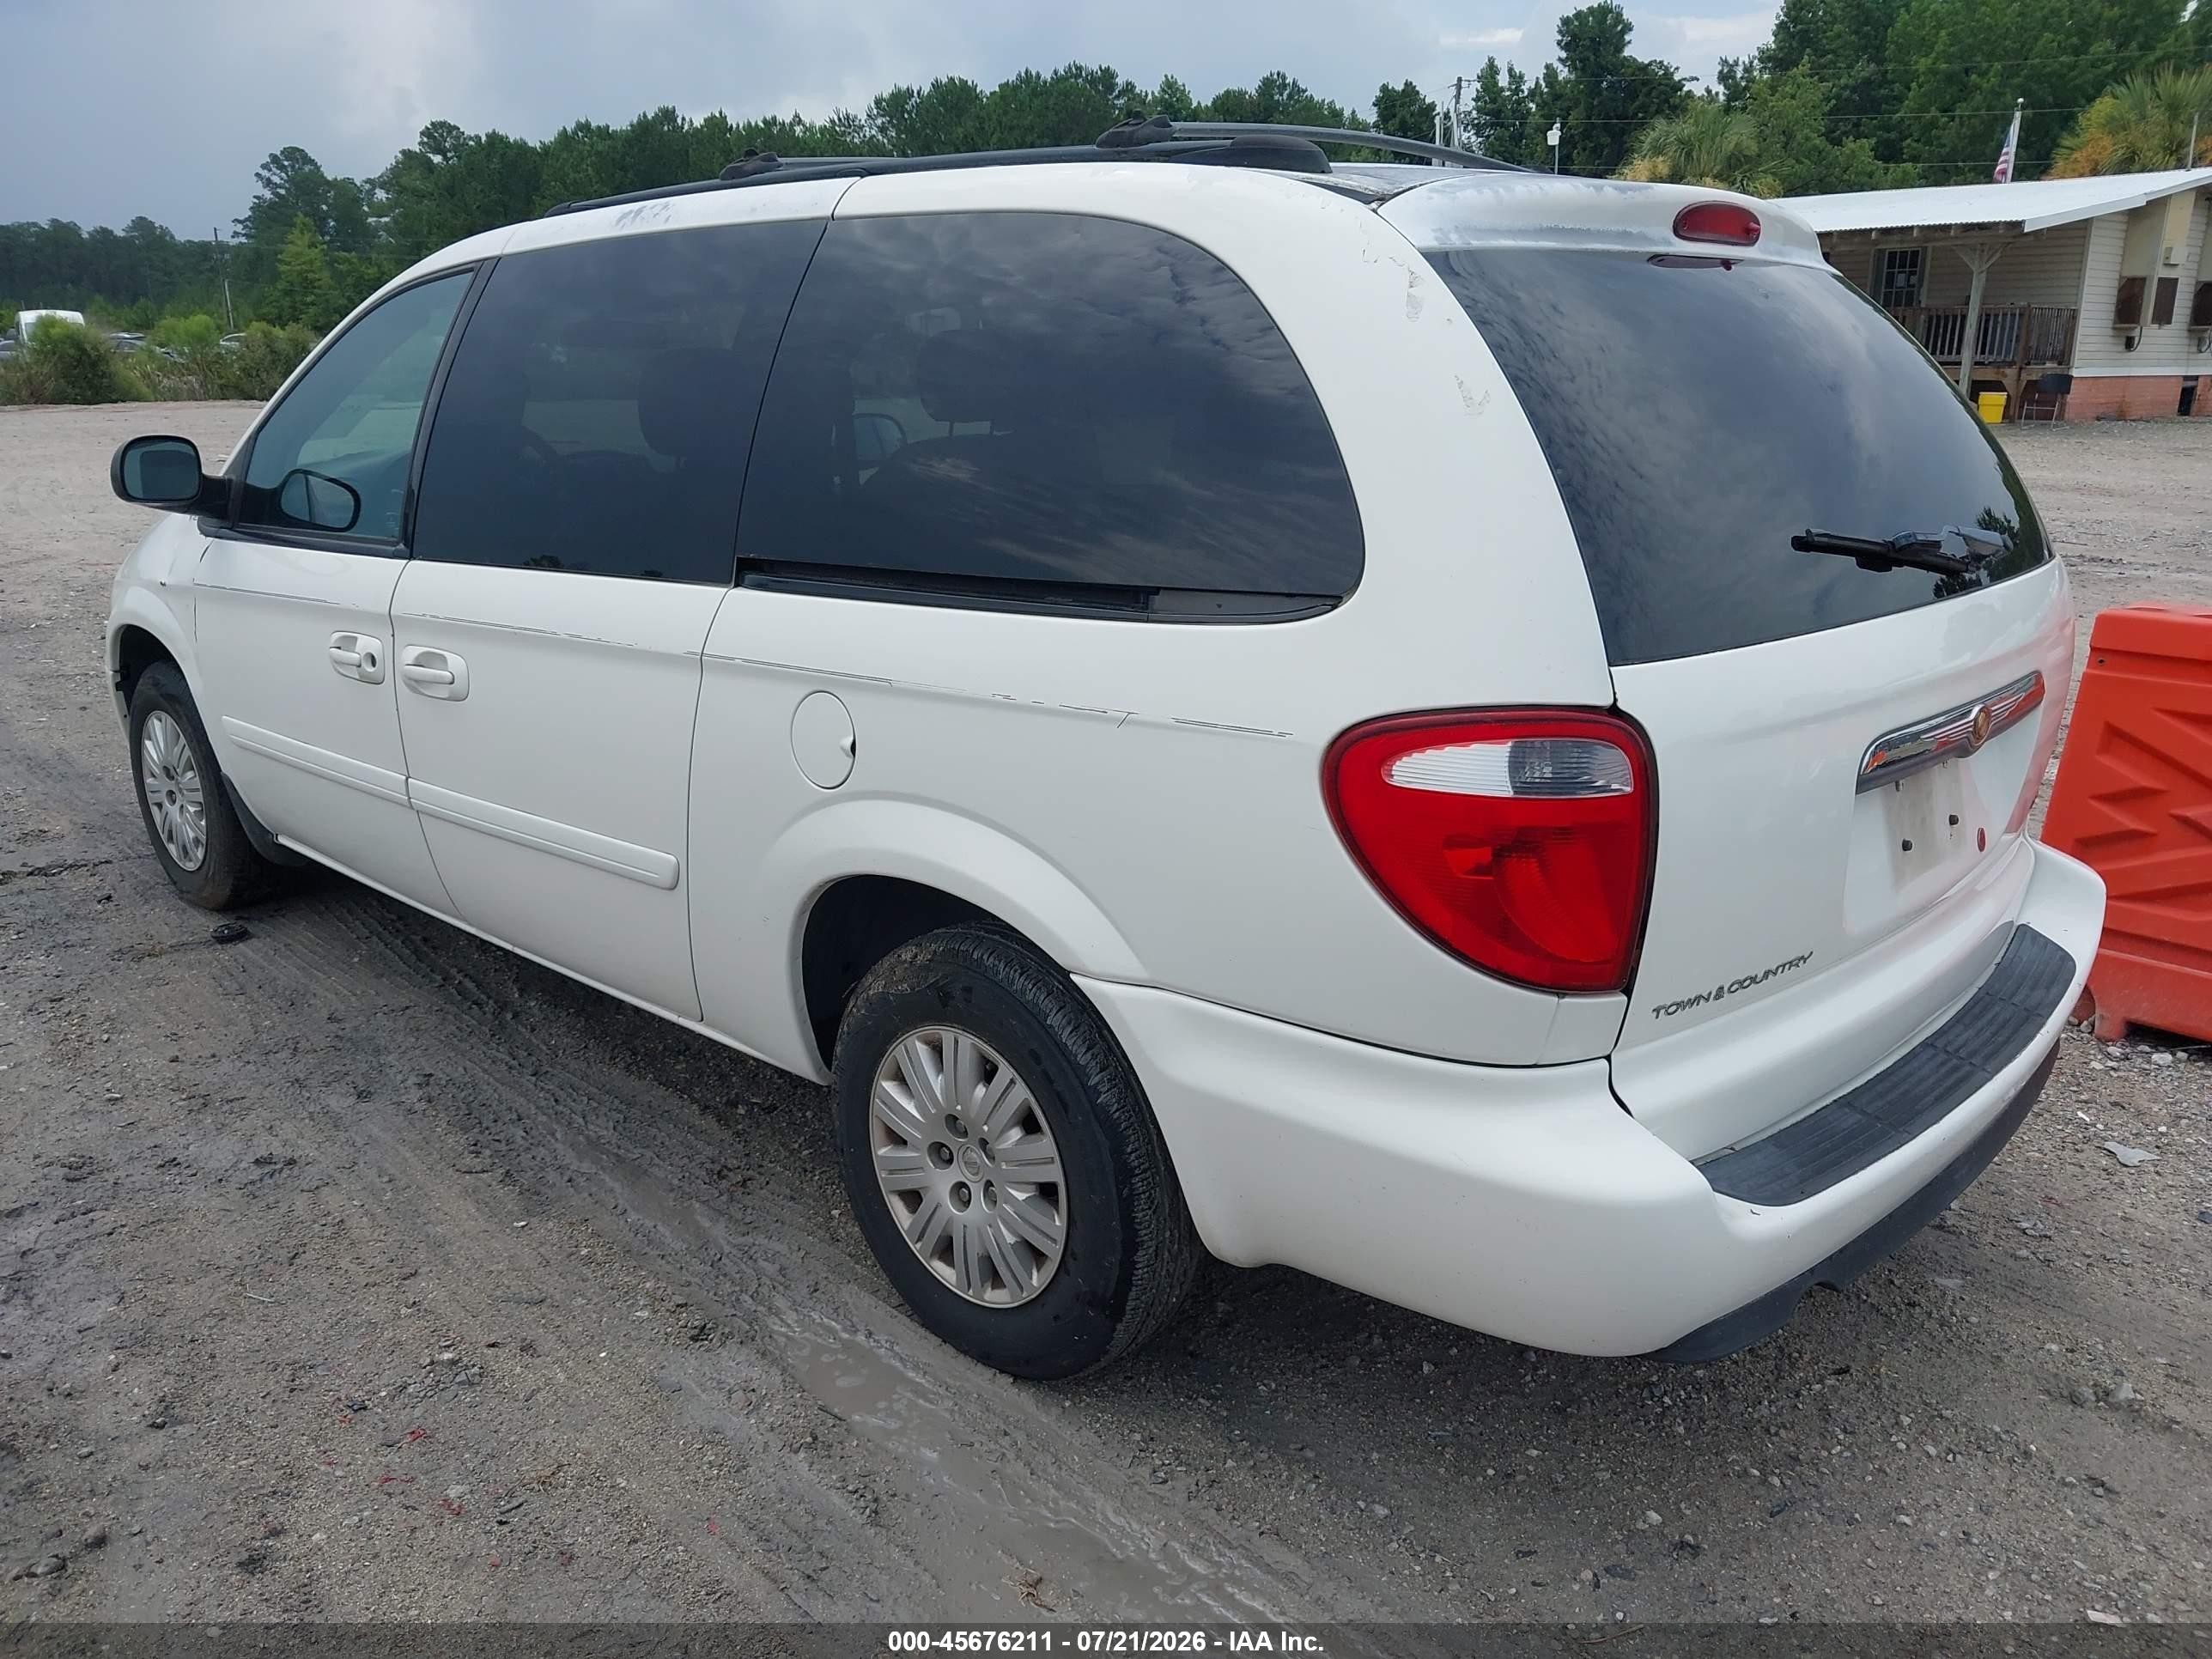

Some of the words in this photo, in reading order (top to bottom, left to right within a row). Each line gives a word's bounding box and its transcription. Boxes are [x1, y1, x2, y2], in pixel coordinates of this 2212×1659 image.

[1652, 991, 1712, 1019] TOWN
[1713, 984, 1724, 1001] &
[1727, 951, 1814, 994] COUNTRY
